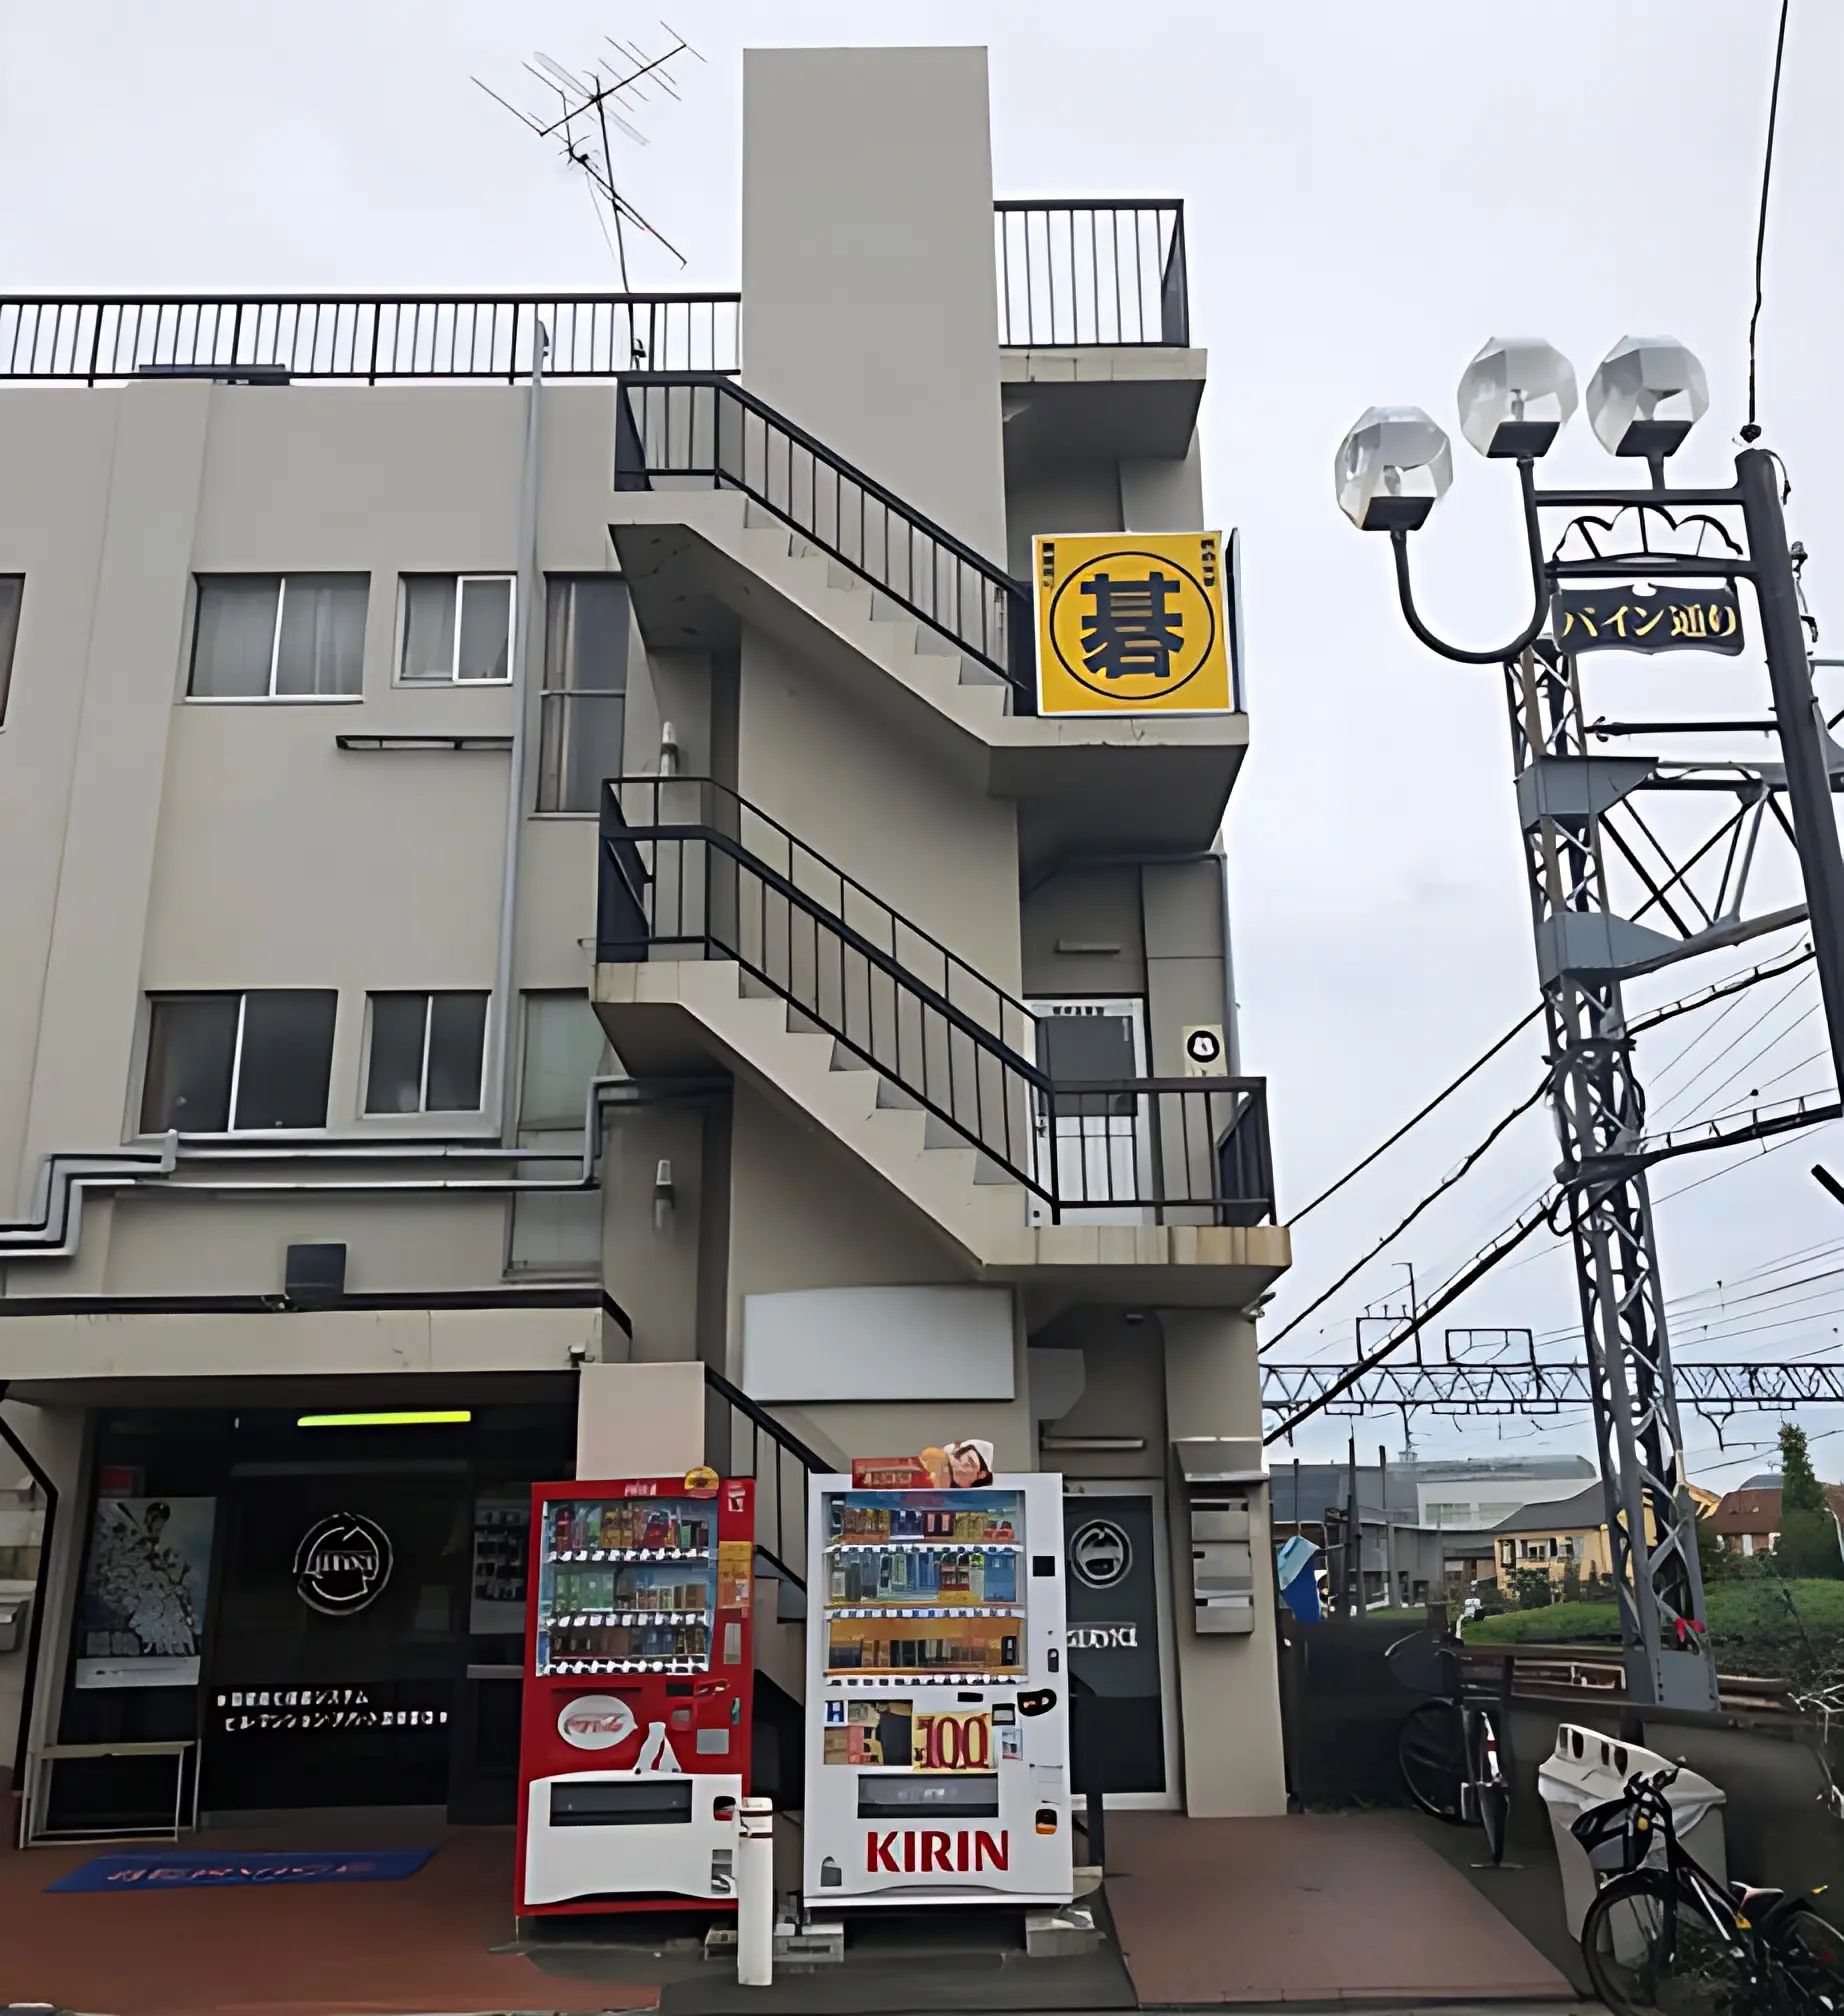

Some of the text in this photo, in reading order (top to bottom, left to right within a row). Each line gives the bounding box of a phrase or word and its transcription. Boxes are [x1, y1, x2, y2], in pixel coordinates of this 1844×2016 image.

[1080, 571, 1184, 679] 碁
[916, 1714, 990, 1769] 100
[867, 1830, 1009, 1873] KIRIN
